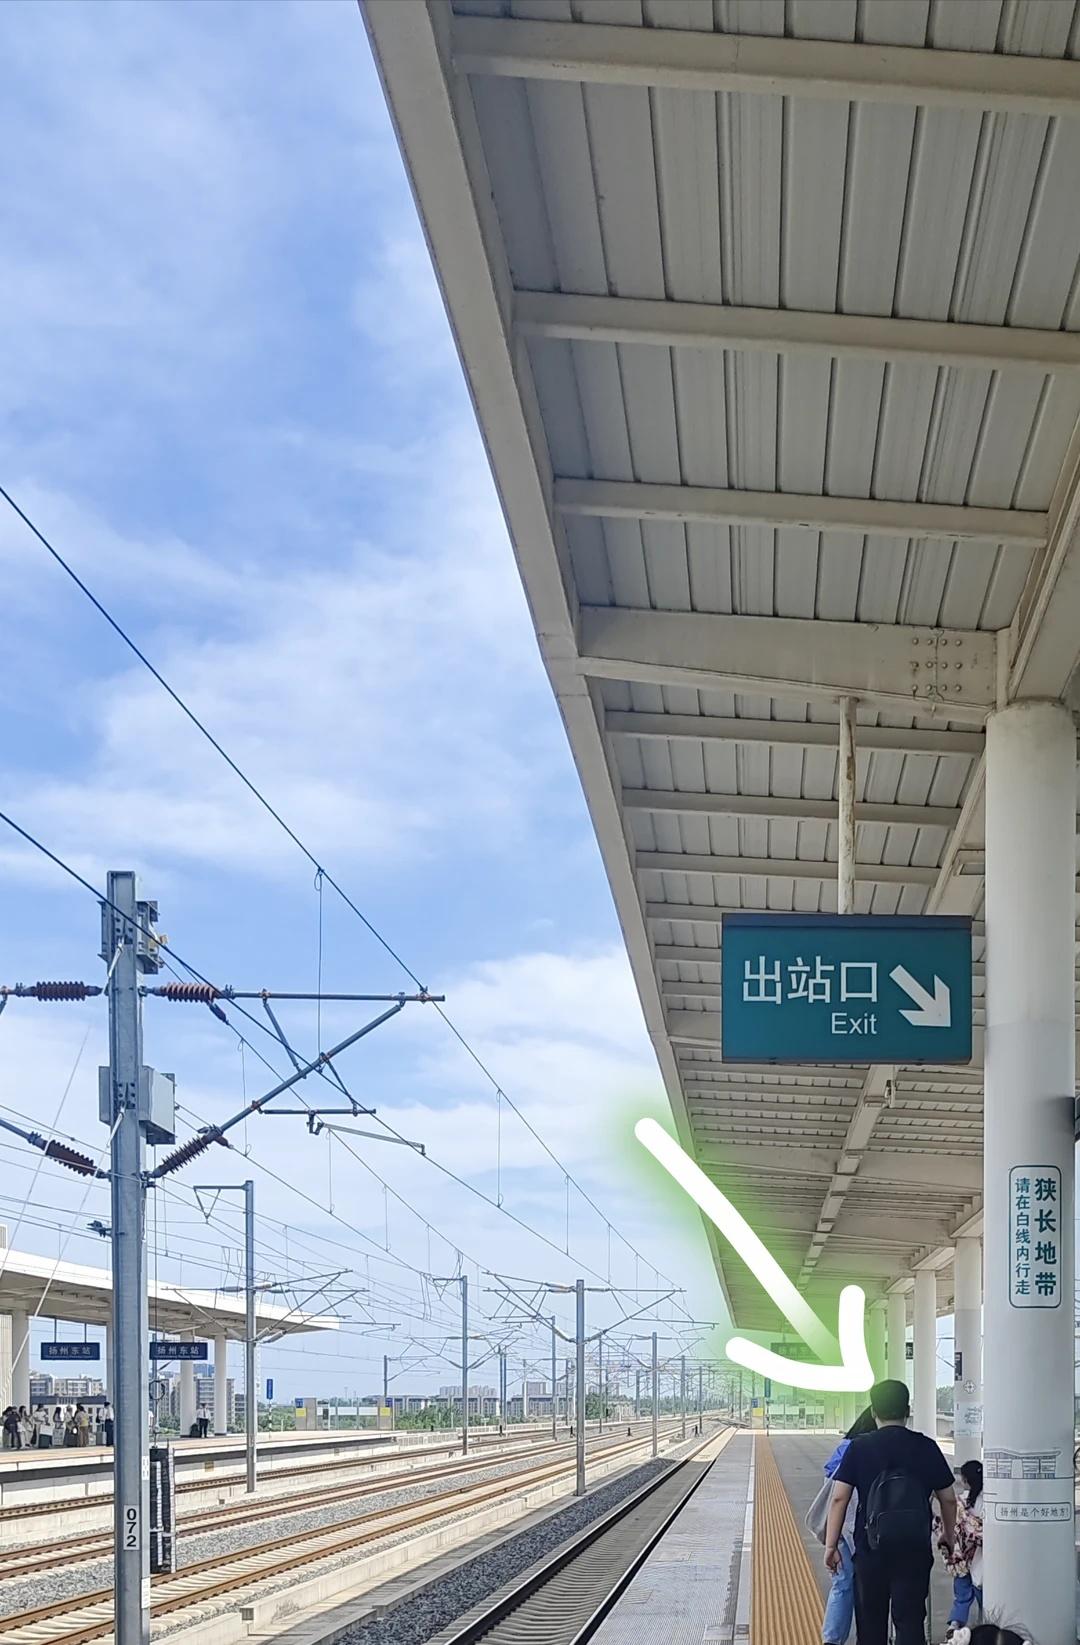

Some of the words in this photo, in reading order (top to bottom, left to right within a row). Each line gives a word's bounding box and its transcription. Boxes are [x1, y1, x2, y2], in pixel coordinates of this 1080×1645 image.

[743, 955, 878, 1004] 出站口
[831, 1012, 877, 1035] Exit
[1015, 1177, 1031, 1295] 请在白线内行走
[1034, 1177, 1057, 1296] 狭长地带
[157, 1345, 200, 1356] 扬州东站
[126, 1508, 137, 1548] 072
